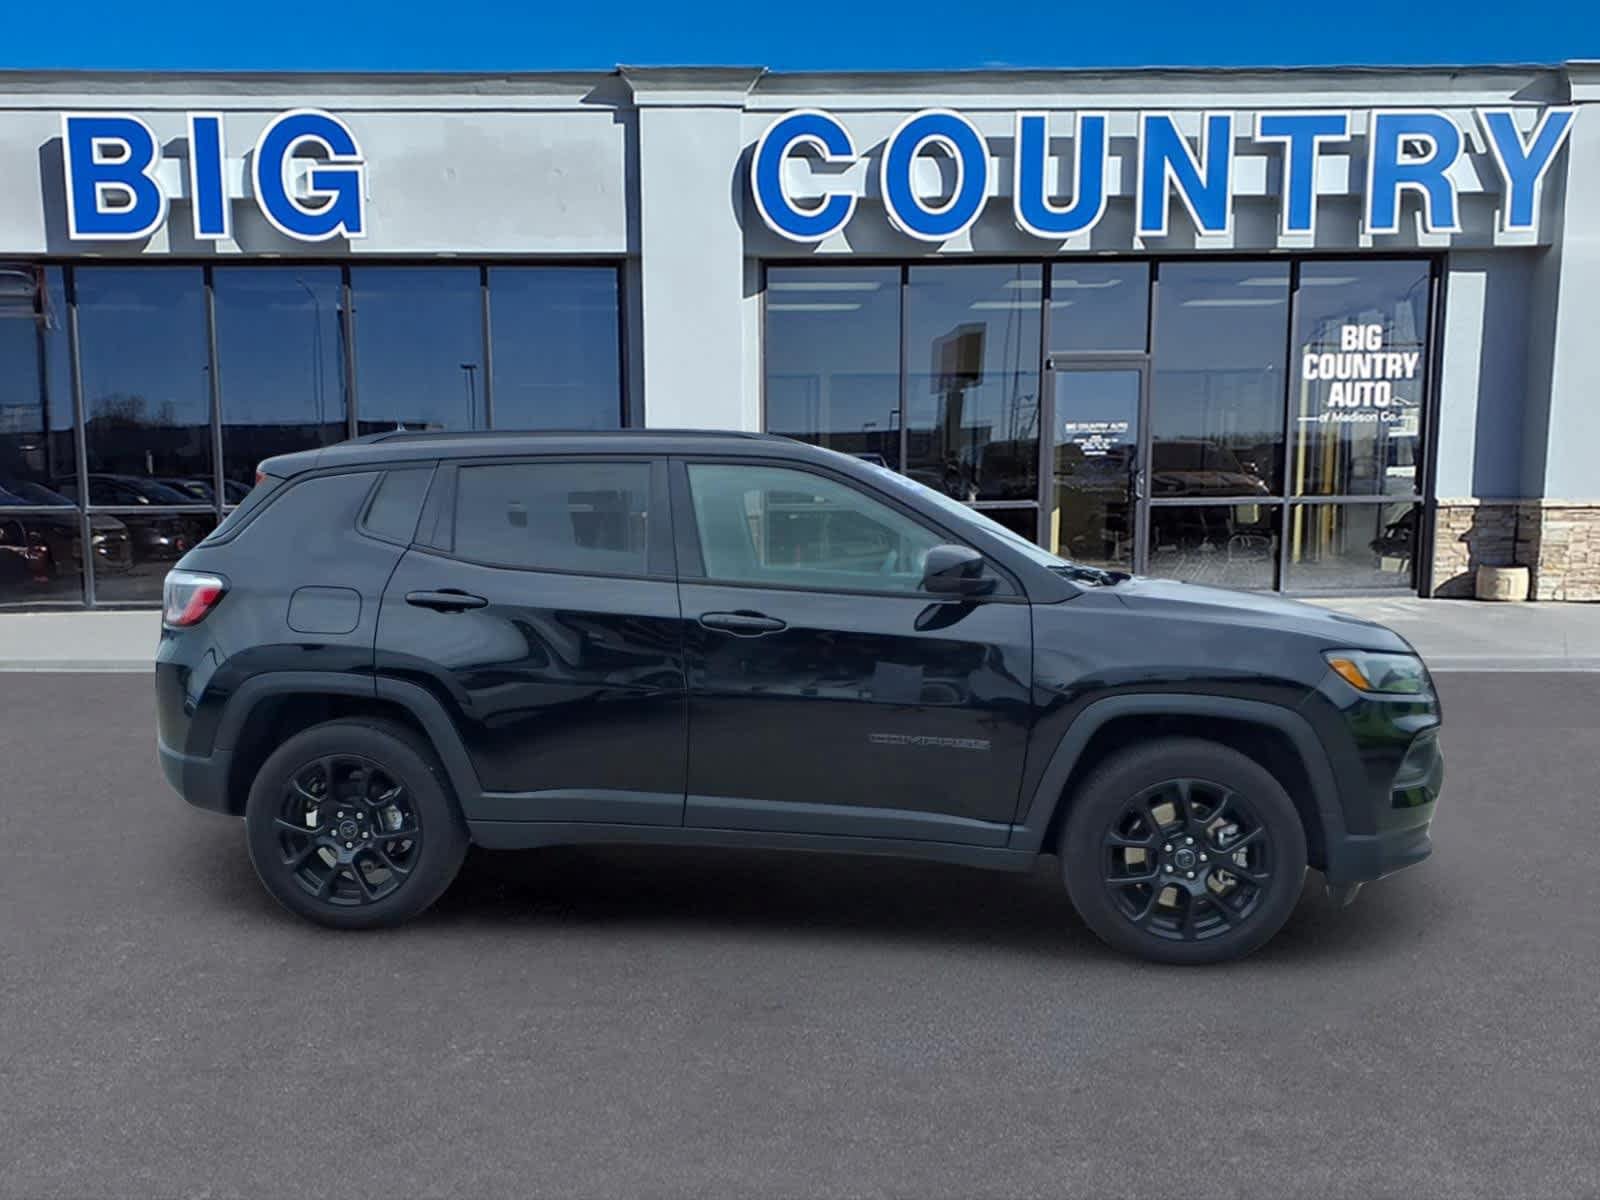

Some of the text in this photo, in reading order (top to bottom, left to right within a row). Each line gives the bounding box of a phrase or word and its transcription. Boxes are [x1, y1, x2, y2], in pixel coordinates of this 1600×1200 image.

[61, 107, 1579, 243] BIG COUNTRY
[1341, 324, 1383, 352] BIG
[1303, 352, 1419, 379] COUNTRY
[1327, 381, 1391, 407] AUTO
[1330, 411, 1379, 422] Madison
